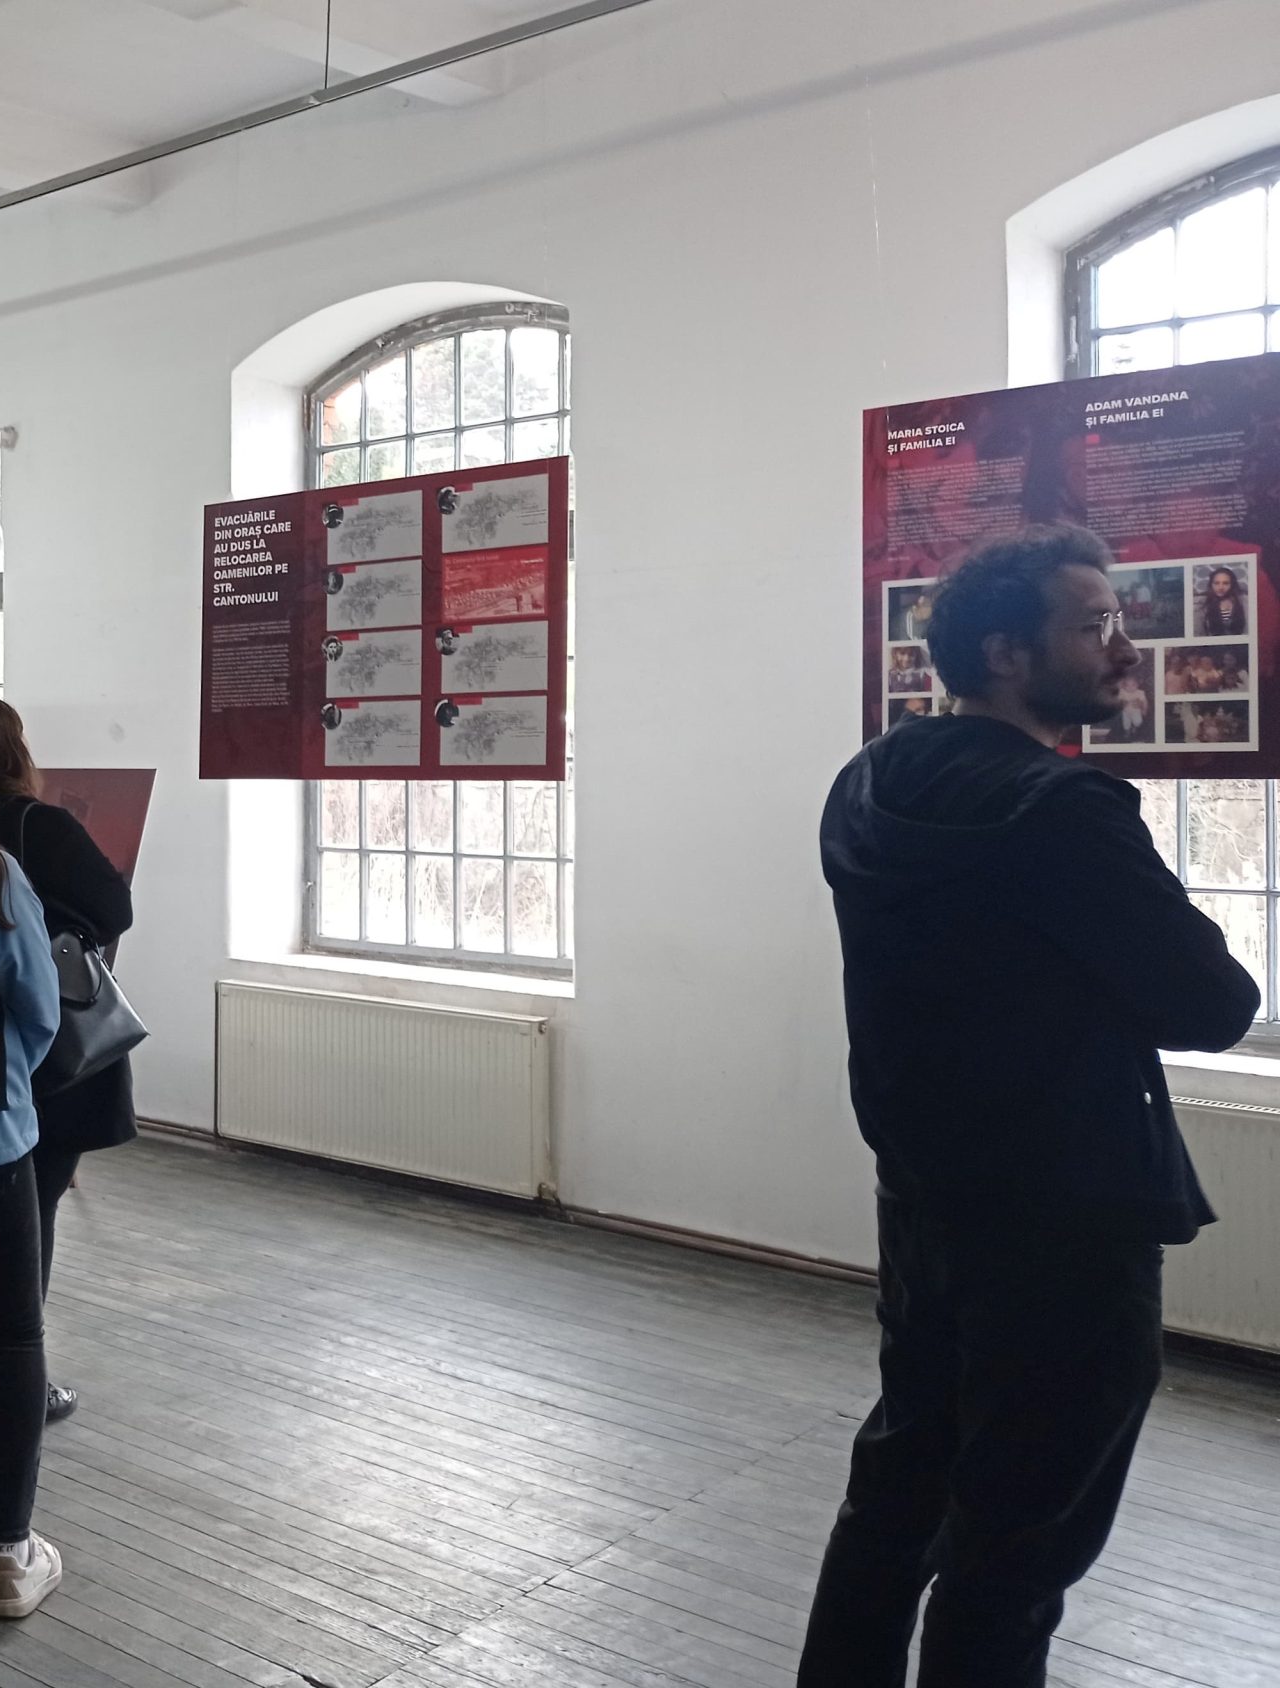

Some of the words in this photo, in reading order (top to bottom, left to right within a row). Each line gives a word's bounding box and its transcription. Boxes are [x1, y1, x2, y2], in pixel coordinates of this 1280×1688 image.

[1085, 399, 1122, 412] ADAM
[1124, 390, 1189, 407] VANDANA
[1100, 410, 1149, 424] FAMILIA
[1152, 408, 1164, 417] EI
[887, 428, 923, 440] MARIA
[925, 421, 965, 435] STOICA
[900, 438, 943, 451] FAMILIA
[945, 436, 956, 446] EI
[214, 510, 276, 527] EVACUĂRILE
[214, 529, 232, 540] DIN
[263, 521, 292, 534] CARE
[214, 543, 228, 554] AU
[230, 540, 251, 552] DUS
[253, 538, 266, 549] LA
[214, 551, 273, 567] RELOCAREA
[213, 565, 273, 580] OAMENILOR
[275, 562, 288, 574] PE
[213, 582, 235, 593] STR.
[213, 591, 279, 607] CANTONULUI
